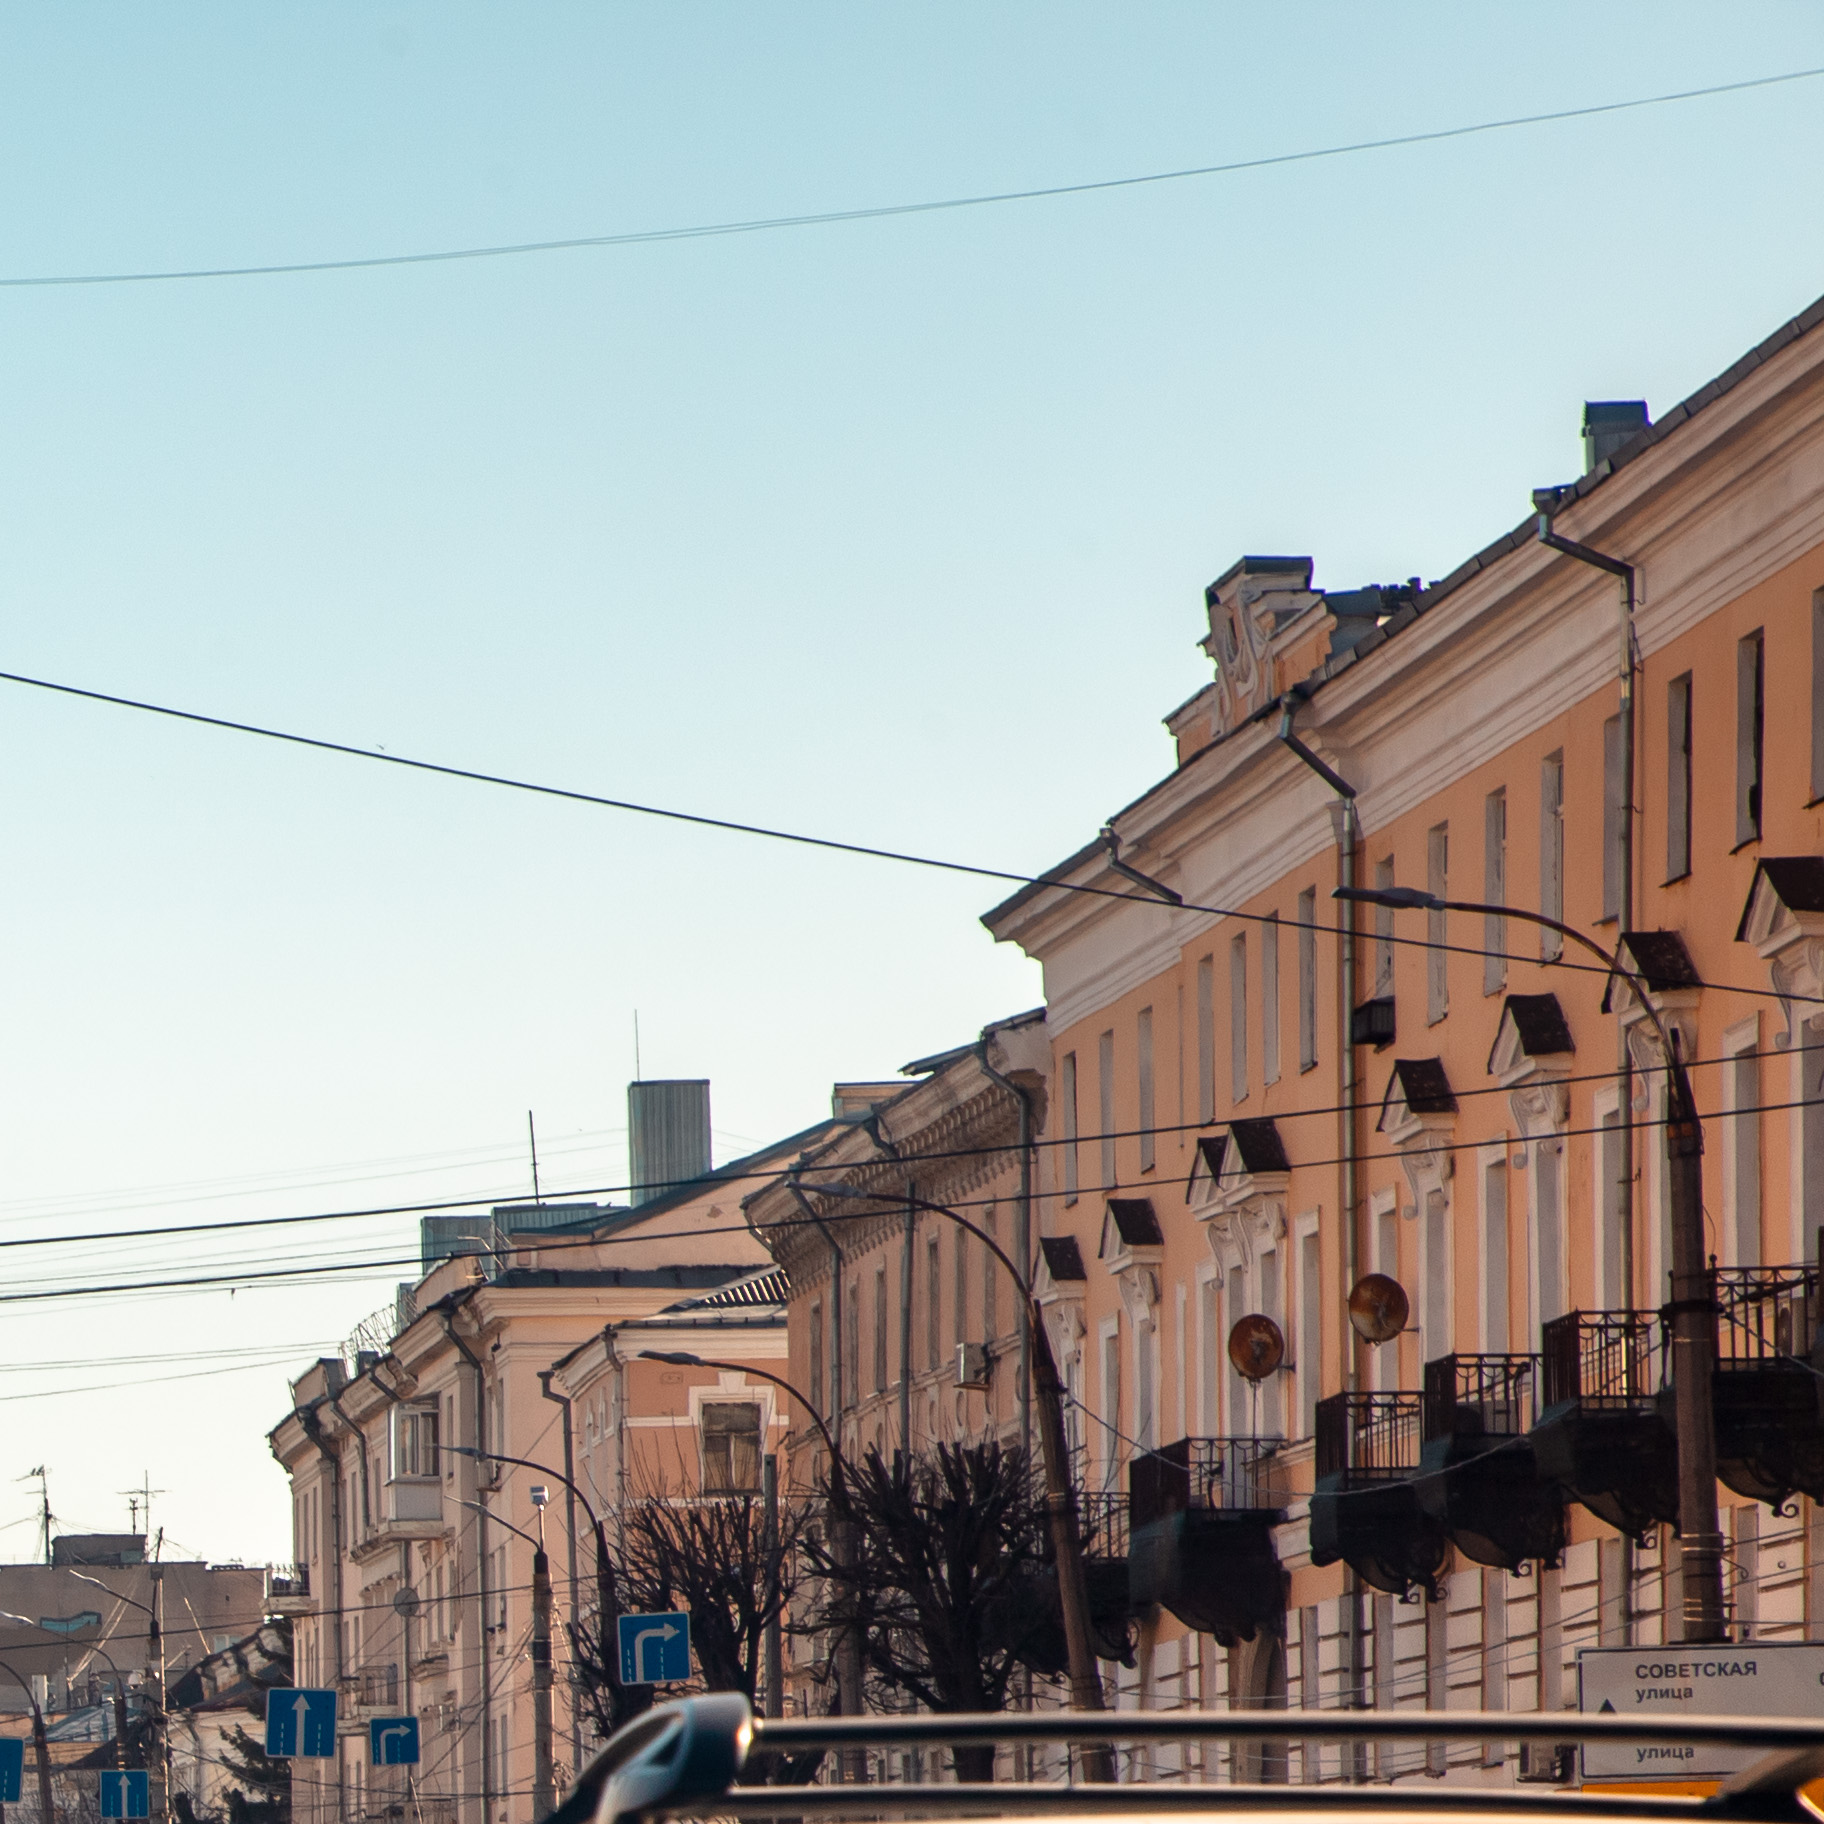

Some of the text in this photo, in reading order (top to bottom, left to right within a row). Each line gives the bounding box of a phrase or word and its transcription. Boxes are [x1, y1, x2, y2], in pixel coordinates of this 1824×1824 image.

[1635, 1660, 1758, 1680] СОВЕТСКАЯ
[1635, 1686, 1694, 1703] улица
[1636, 1747, 1695, 1762] улица
